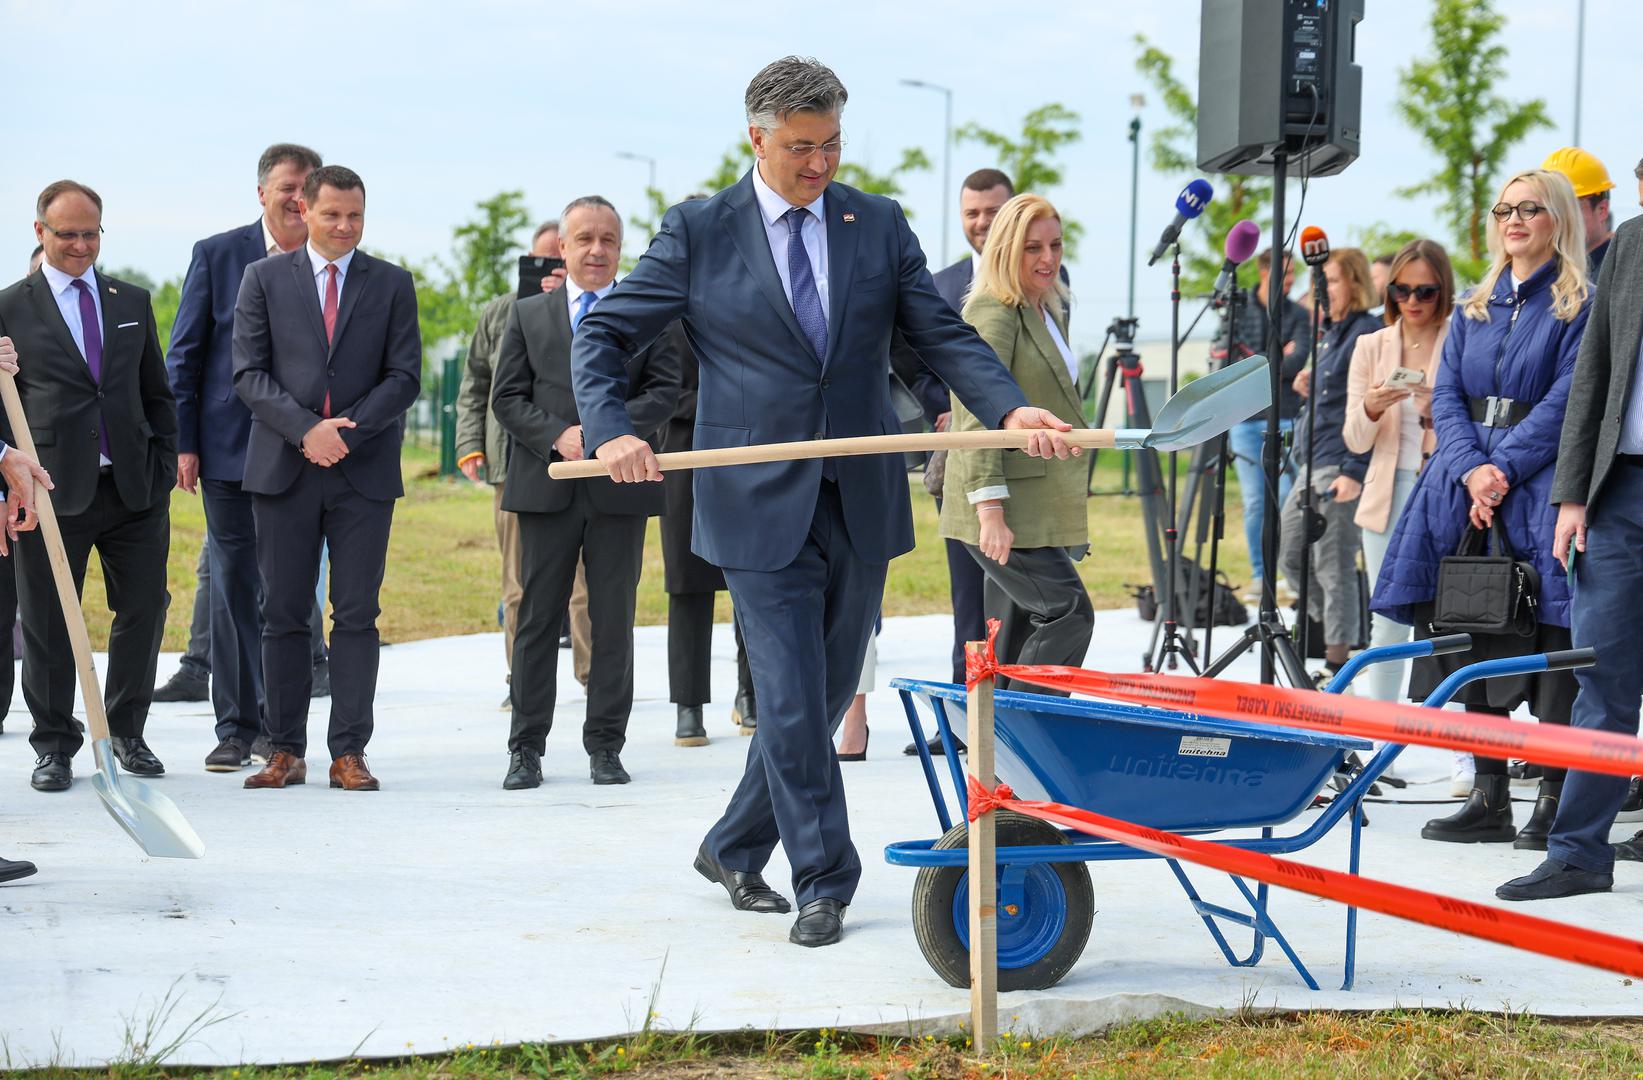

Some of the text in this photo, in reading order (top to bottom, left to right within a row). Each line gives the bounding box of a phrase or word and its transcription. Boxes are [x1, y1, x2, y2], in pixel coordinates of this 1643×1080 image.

[1181, 189, 1200, 208] N1
[1236, 695, 1345, 726] ENERGETSKI KABEL
[1179, 748, 1226, 756] unitehna
